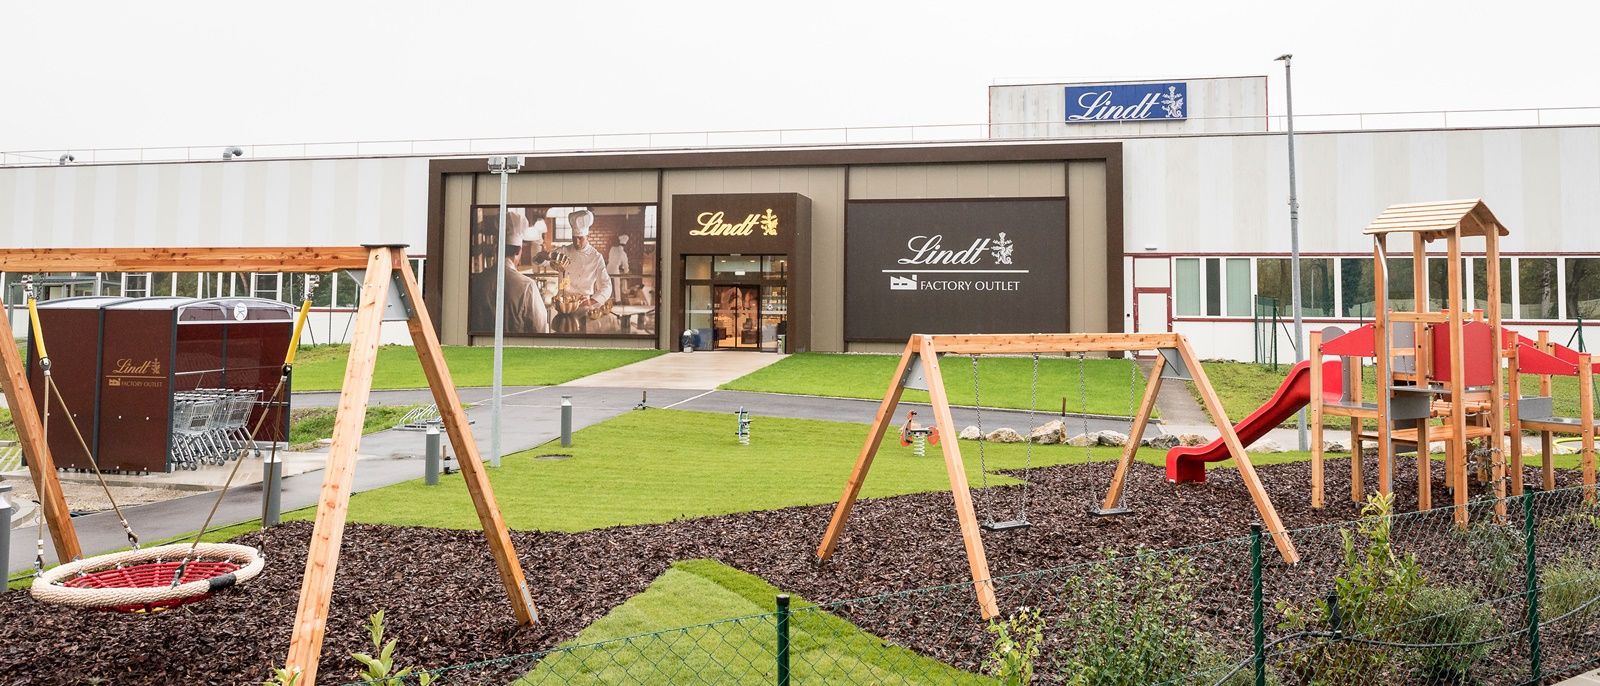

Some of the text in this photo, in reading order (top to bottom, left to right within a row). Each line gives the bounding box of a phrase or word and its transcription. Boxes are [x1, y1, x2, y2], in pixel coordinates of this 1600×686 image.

[1068, 91, 1161, 120] Lindt
[689, 211, 760, 236] Lindt
[898, 234, 991, 265] Lindt
[920, 280, 1020, 291] FACTORY OUTLET
[112, 358, 151, 374] Lindt
